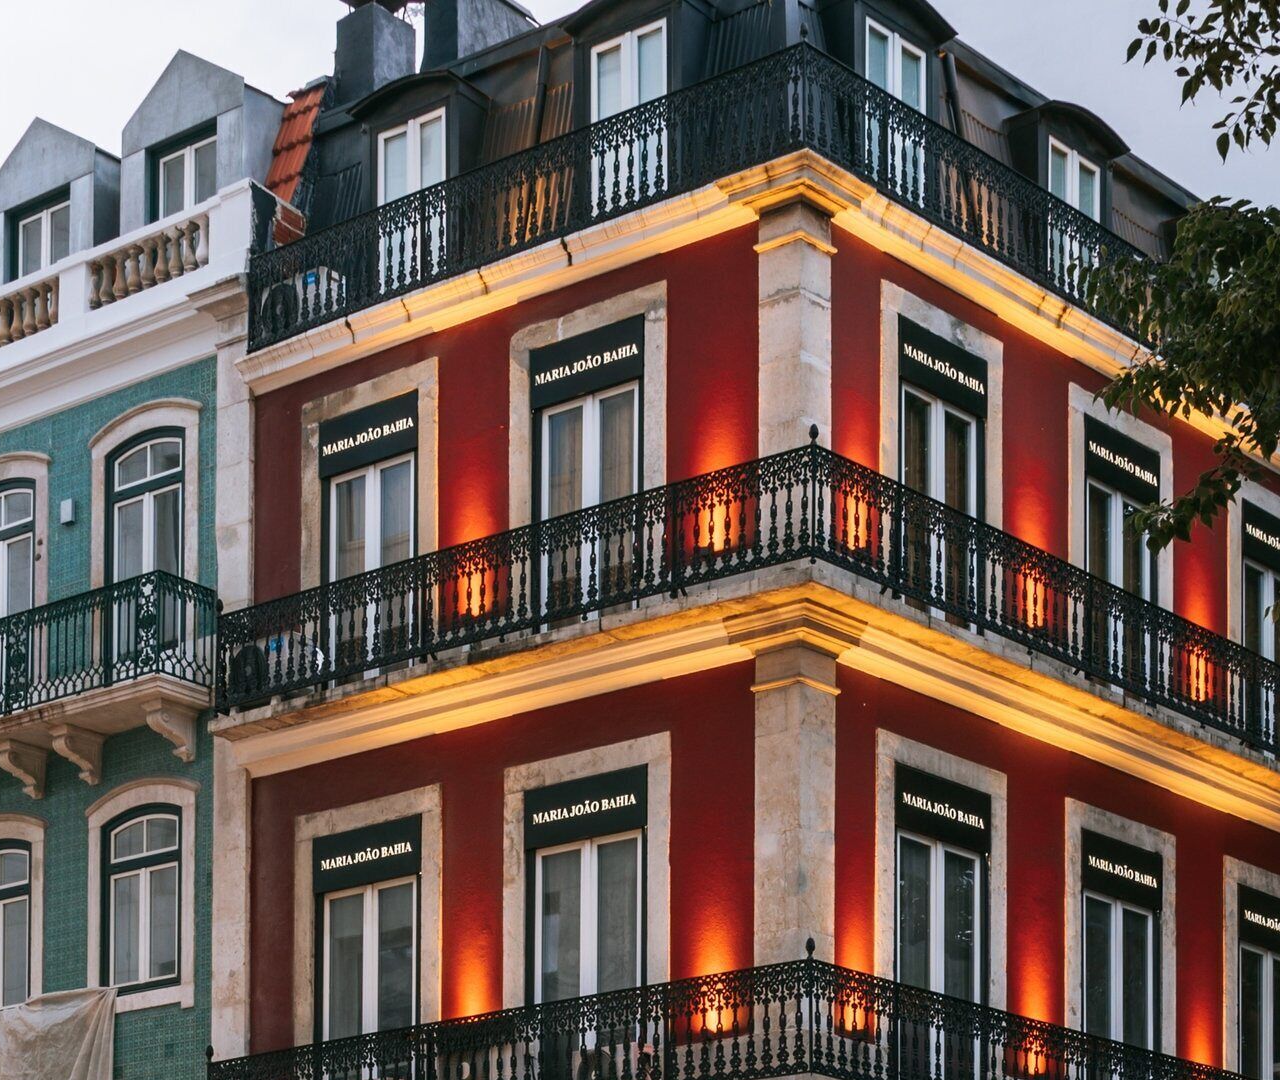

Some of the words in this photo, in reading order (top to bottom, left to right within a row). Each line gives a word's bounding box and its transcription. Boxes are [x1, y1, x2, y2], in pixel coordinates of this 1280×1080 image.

[534, 365, 570, 386] MARIA
[571, 355, 601, 375] JOÃO
[603, 343, 638, 364] BAHIA
[904, 343, 933, 368] MARIA
[933, 360, 957, 380] JOÃO
[958, 371, 985, 395] BAHIA
[322, 437, 355, 456] MARIA
[355, 428, 381, 446] JOÃO
[383, 417, 414, 436] BAHIA
[1089, 441, 1114, 463] MARIA
[1114, 455, 1134, 474] JOÃO
[1135, 467, 1158, 487] BAHIA
[1245, 523, 1267, 544] MARIA
[532, 808, 569, 825] MARIA
[569, 800, 600, 817] JOÃO
[601, 794, 637, 811] BAHIA
[902, 792, 933, 812] MARIA
[933, 803, 957, 820] JOÃO
[958, 810, 985, 830] BAHIA
[321, 855, 353, 871] MARIA
[353, 848, 380, 864] JOÃO
[381, 842, 412, 859] BAHIA
[1088, 855, 1113, 873] MARIA
[1114, 865, 1134, 880] JOÃO
[1135, 871, 1158, 889] BAHIA
[1244, 910, 1266, 926] MARIA
